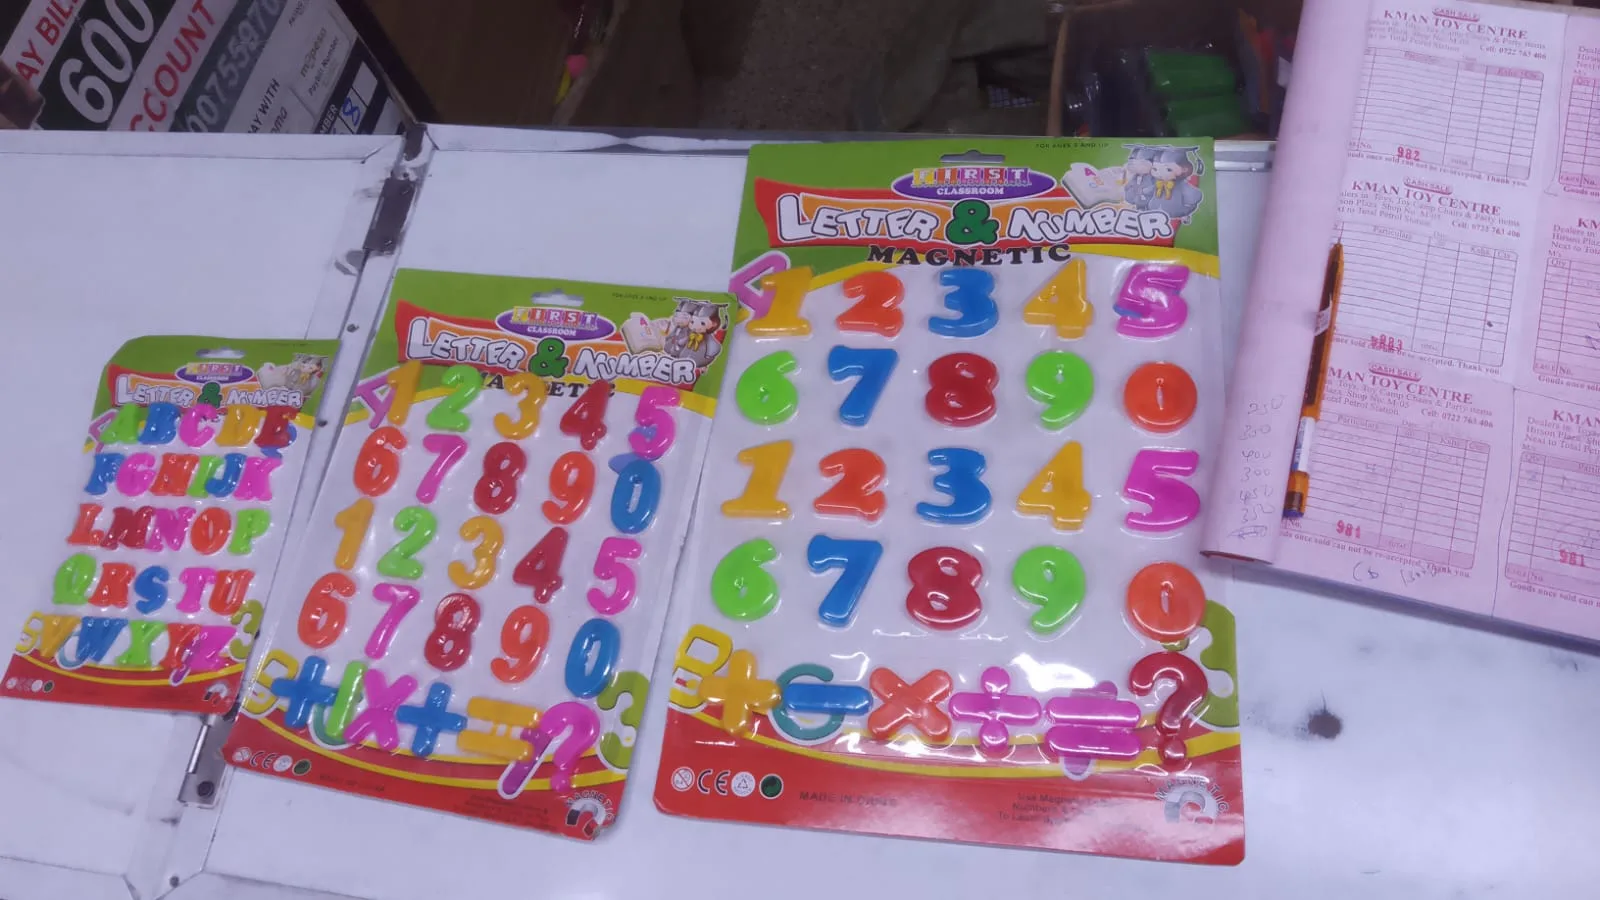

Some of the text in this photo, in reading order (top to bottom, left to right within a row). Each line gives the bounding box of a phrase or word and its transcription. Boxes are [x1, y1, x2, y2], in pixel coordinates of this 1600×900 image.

[1384, 9, 1431, 24] KMAN
[1434, 17, 1461, 31] TOY
[1466, 24, 1529, 39] CENTRE
[16, 38, 45, 81] AY
[128, 0, 215, 131] CCOUNT
[258, 78, 281, 116] WITH
[1397, 144, 1421, 161] 982
[911, 166, 1031, 187] FIRST
[936, 186, 1005, 196] CLASSROOM
[1351, 179, 1503, 217] KMAN TOY CENTRE
[776, 195, 1174, 247] LETTER & NUMBER
[866, 243, 1073, 267] MAGNETIC
[746, 258, 1190, 340] 1 2 3 4 5
[513, 305, 599, 331] FIRST
[527, 326, 578, 337] CLASSROOM
[407, 317, 526, 371] LETTER
[528, 336, 569, 378] &
[573, 348, 698, 385] NUMBER
[1371, 362, 1396, 374] CASH
[114, 374, 196, 408] LETTER
[734, 345, 1198, 434] 6 7 8 9 0
[1328, 366, 1475, 406] MAN TOY CENTRE
[1420, 407, 1439, 418] Cell:
[721, 439, 1201, 533] 1 2 3 4 5
[1336, 518, 1361, 540] 981
[1559, 548, 1585, 568] 981
[711, 534, 1207, 643] 6 7 8 9 0
